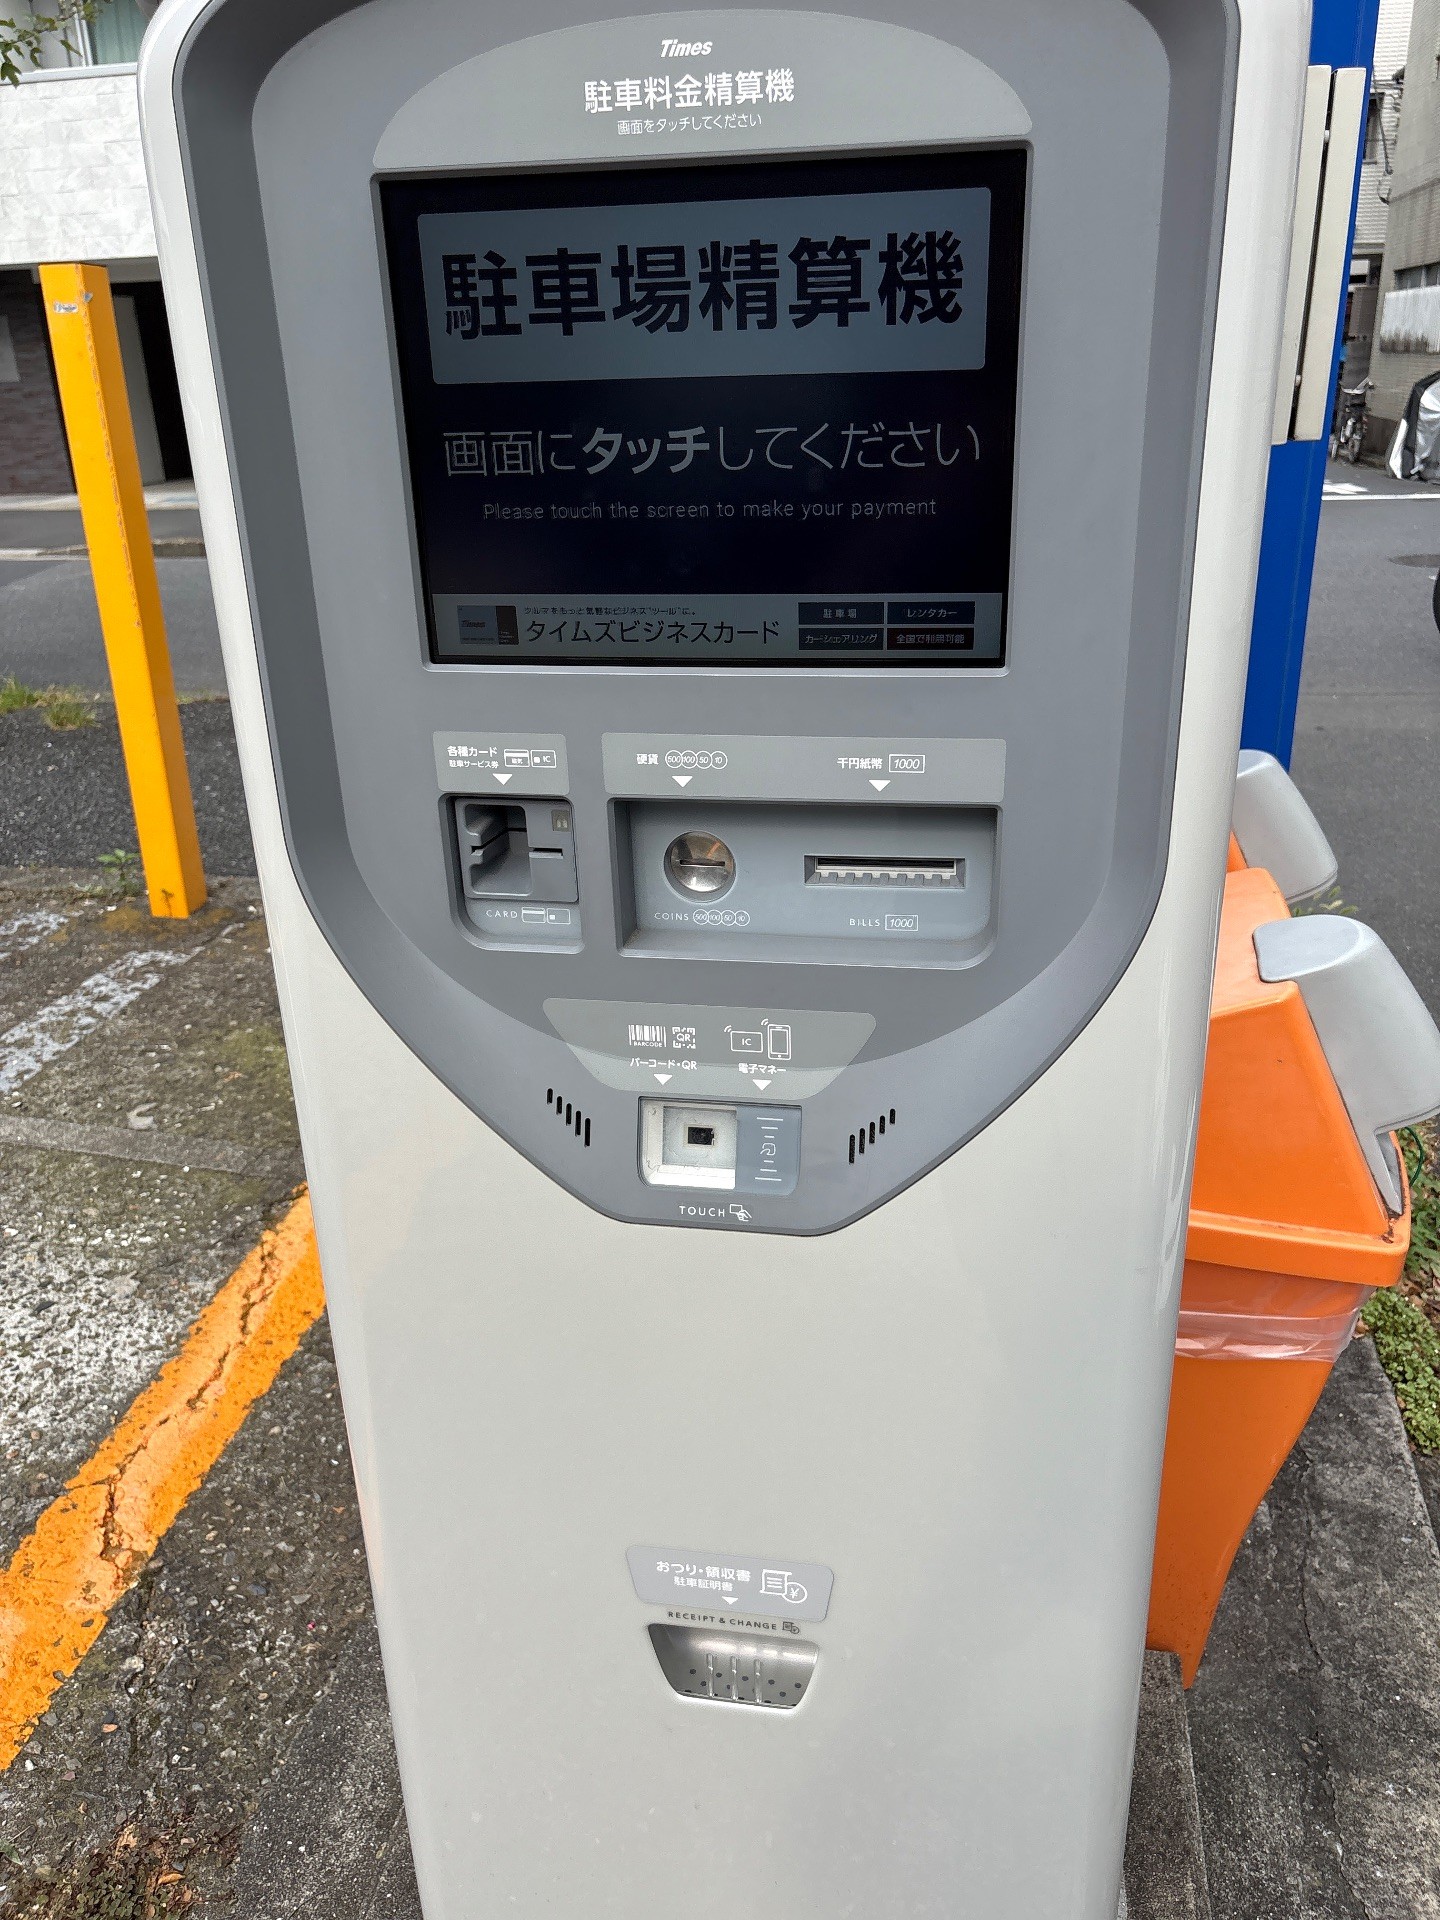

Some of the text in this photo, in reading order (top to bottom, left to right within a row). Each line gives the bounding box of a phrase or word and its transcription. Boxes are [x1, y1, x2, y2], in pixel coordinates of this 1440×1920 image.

[660, 38, 713, 59] Times
[584, 68, 795, 113] 駐車料金精算機
[617, 113, 762, 136] 画面をタッチしてください
[442, 229, 965, 341] 駐車場精算機
[442, 421, 982, 478] 画面にタッチしてください
[482, 498, 937, 521] Please touch the screen to make your payment
[906, 607, 958, 619] レンタカー
[525, 618, 780, 645] タイムズビジネスカード
[447, 745, 498, 758] 各種カード
[837, 757, 882, 769] 千円紙幣
[893, 758, 921, 770] 1000
[485, 909, 518, 919] CARD
[654, 911, 689, 921] COINS
[849, 917, 880, 927] BILLS
[889, 917, 915, 928] 1000
[677, 1033, 691, 1042] QR
[741, 1038, 751, 1046] IC
[633, 1040, 663, 1048] BARCODE
[629, 1057, 698, 1071] バーコード・QR
[738, 1063, 787, 1075] 電子マネー
[679, 1206, 725, 1217] TOUCH
[656, 1561, 751, 1582] おつり・領収書
[674, 1577, 733, 1592] 駐車証明書
[668, 1611, 777, 1630] RECEIPT & CHANGE
